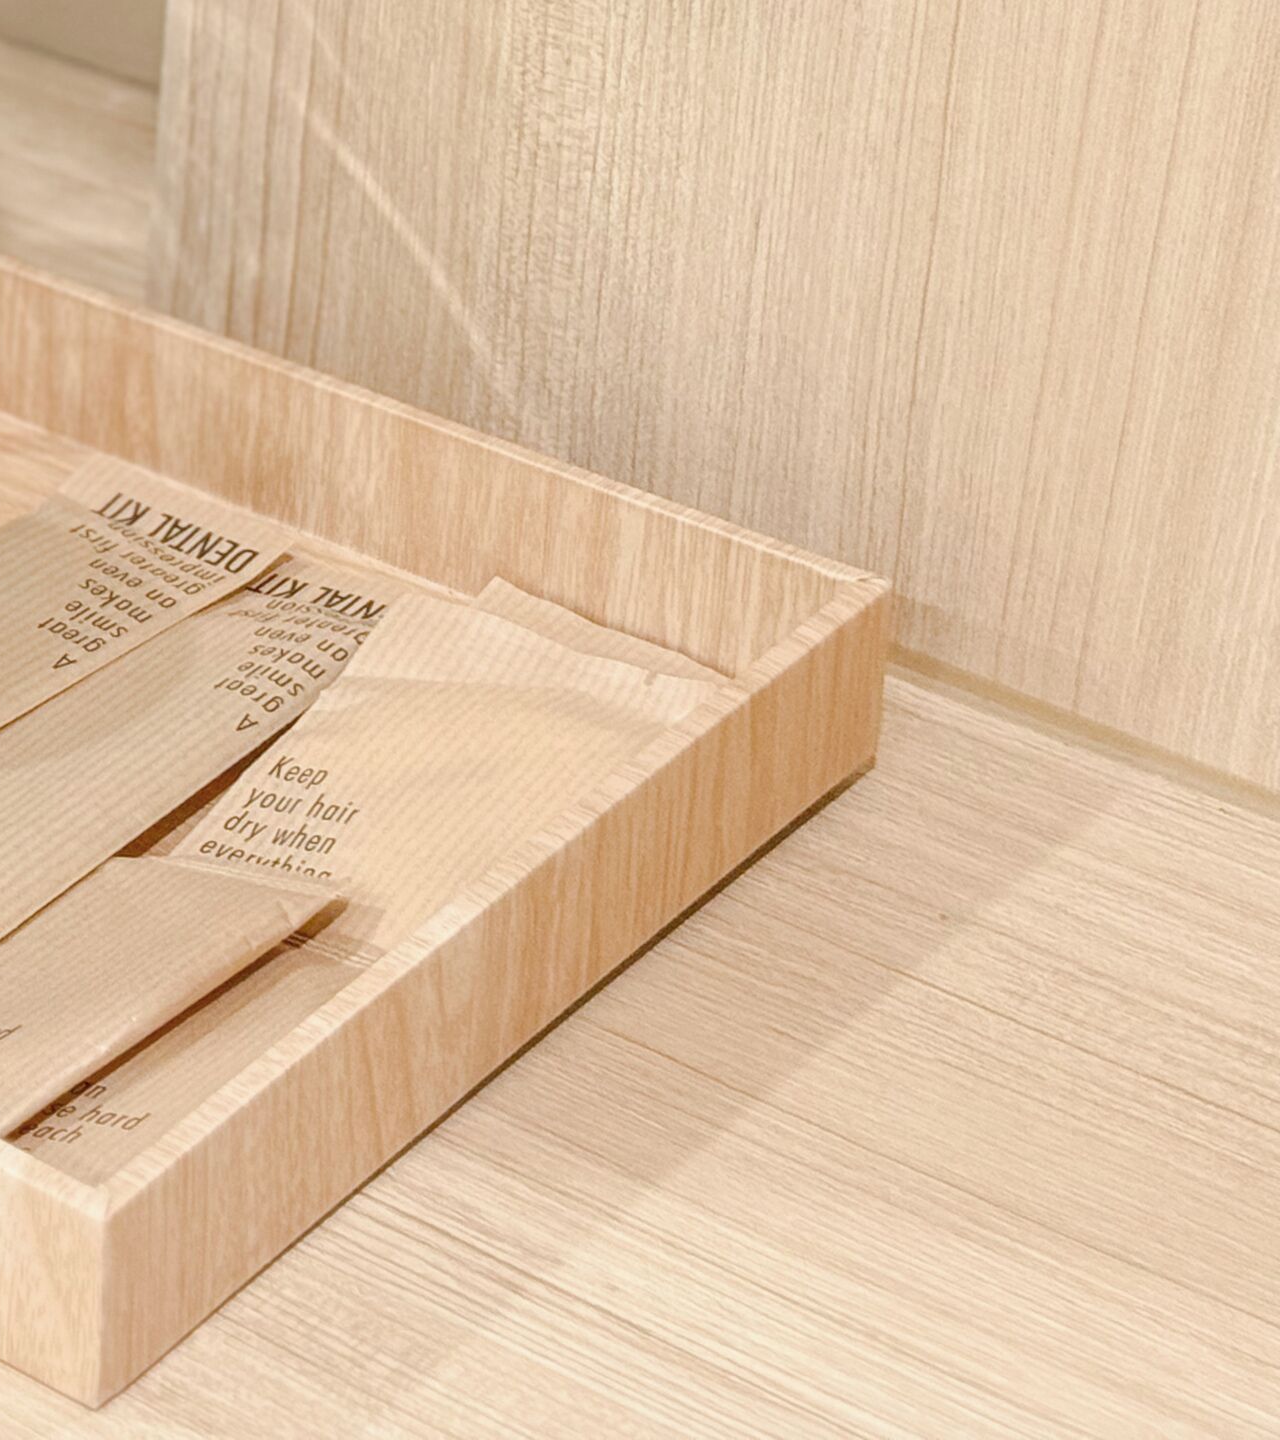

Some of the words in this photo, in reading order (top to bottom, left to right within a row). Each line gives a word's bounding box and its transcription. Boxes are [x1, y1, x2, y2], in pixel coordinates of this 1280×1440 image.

[90, 492, 151, 528] KIT
[69, 523, 120, 554] first
[148, 512, 260, 575] DENTAL
[90, 558, 144, 588] even
[120, 550, 207, 596] greater
[244, 573, 309, 599] KIT
[78, 578, 153, 624] makes
[145, 588, 178, 609] an
[310, 586, 387, 620] NTAL
[37, 616, 107, 653] great
[64, 600, 129, 638] smile
[253, 626, 312, 644] even
[52, 653, 78, 670] A
[248, 644, 327, 680] makes
[315, 638, 349, 662] an
[214, 677, 285, 713] great
[237, 661, 305, 697] smile
[235, 713, 259, 732] A
[267, 754, 329, 789] Keep
[242, 787, 303, 816] your
[308, 794, 361, 825] hair
[223, 811, 268, 842] dry
[272, 824, 337, 855] when
[78, 1103, 152, 1131] hard
